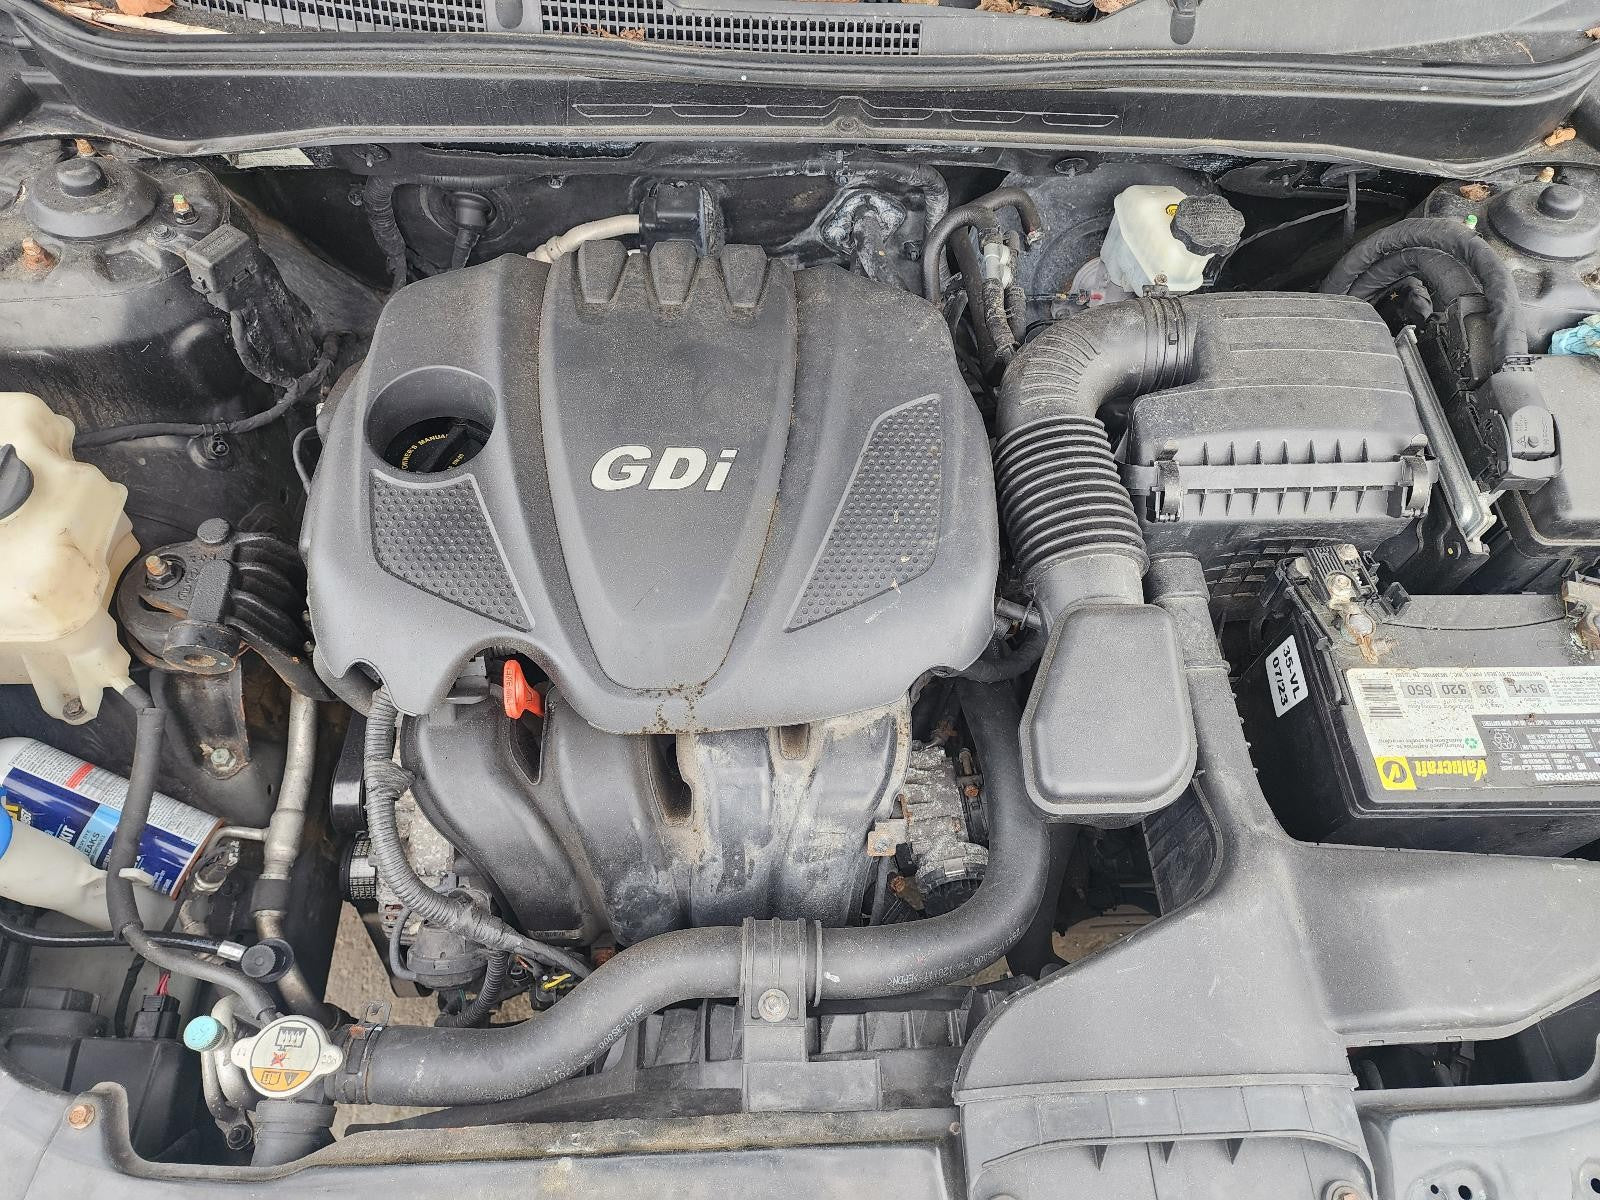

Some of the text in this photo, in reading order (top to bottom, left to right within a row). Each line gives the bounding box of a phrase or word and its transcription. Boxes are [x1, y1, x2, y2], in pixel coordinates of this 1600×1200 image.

[590, 445, 739, 491] GDi
[1272, 656, 1289, 707] 07/23
[1283, 644, 1300, 700] 35-VL
[1407, 684, 1433, 697] 650
[1479, 684, 1495, 695] 35
[1415, 759, 1488, 782] Valucraft
